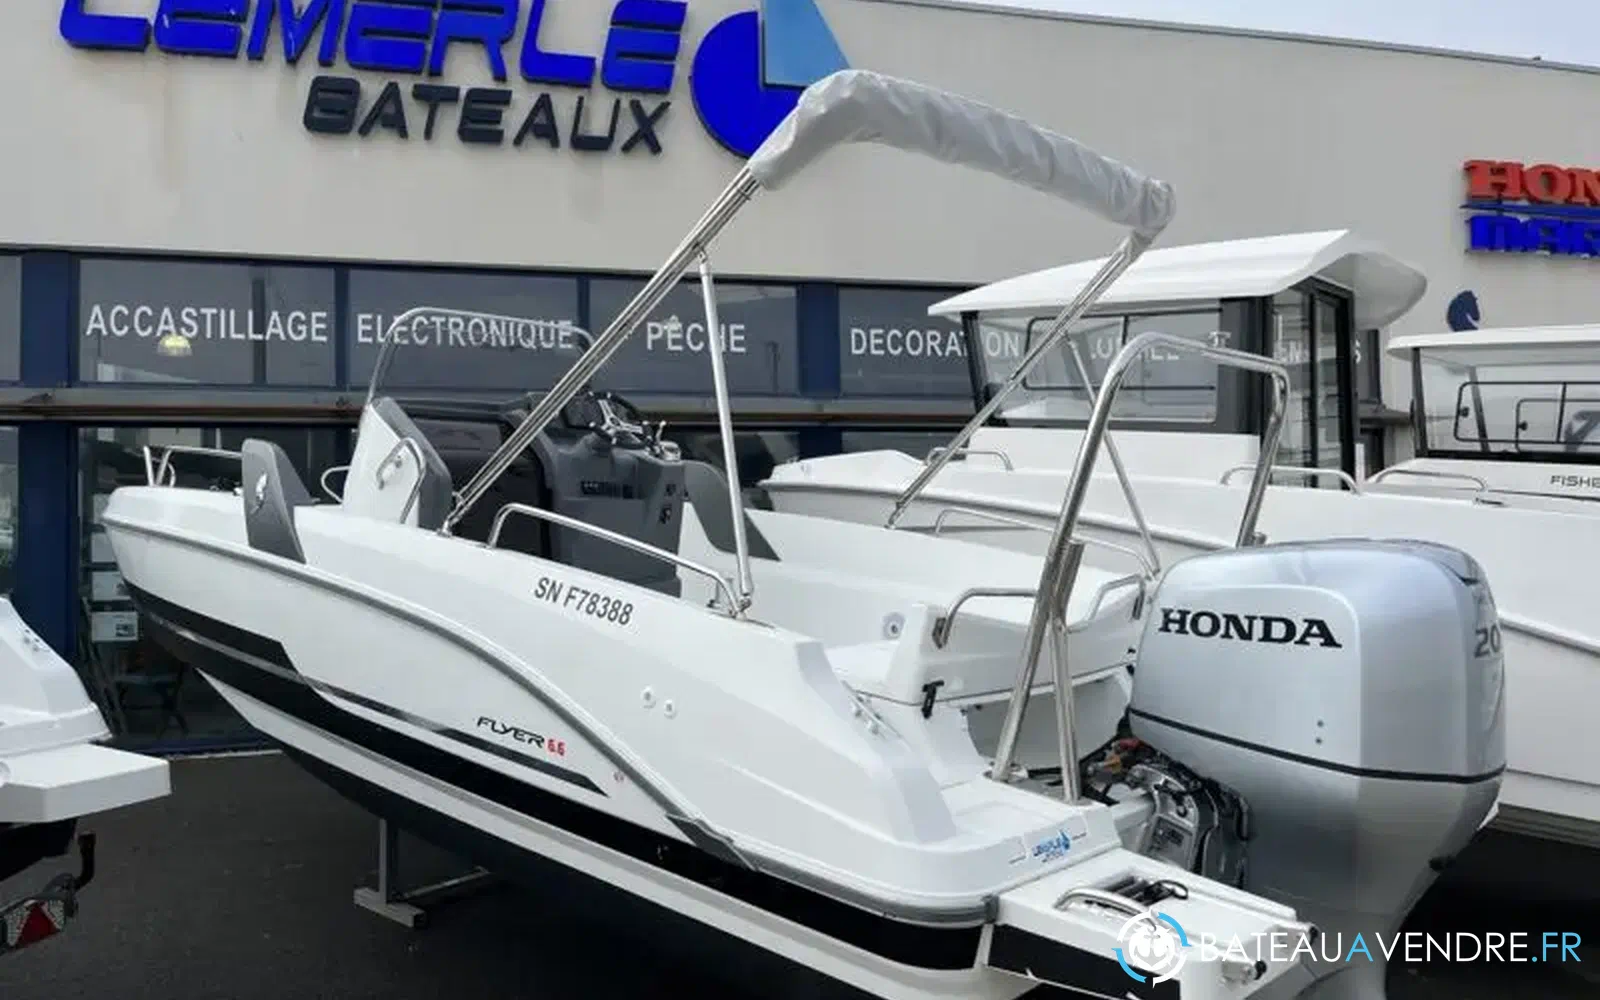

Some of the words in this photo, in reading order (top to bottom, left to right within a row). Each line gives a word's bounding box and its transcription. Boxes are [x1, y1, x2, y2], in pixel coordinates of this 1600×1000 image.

[303, 75, 671, 154] BATEAUX
[86, 305, 328, 342] ACCASTILLAGE
[356, 312, 576, 350] ELECTRONIQUE
[851, 327, 1020, 357] DECORAON
[534, 577, 563, 603] SN
[563, 586, 633, 625] F78388
[1158, 607, 1342, 648] HONDA
[477, 716, 545, 748] FLYER
